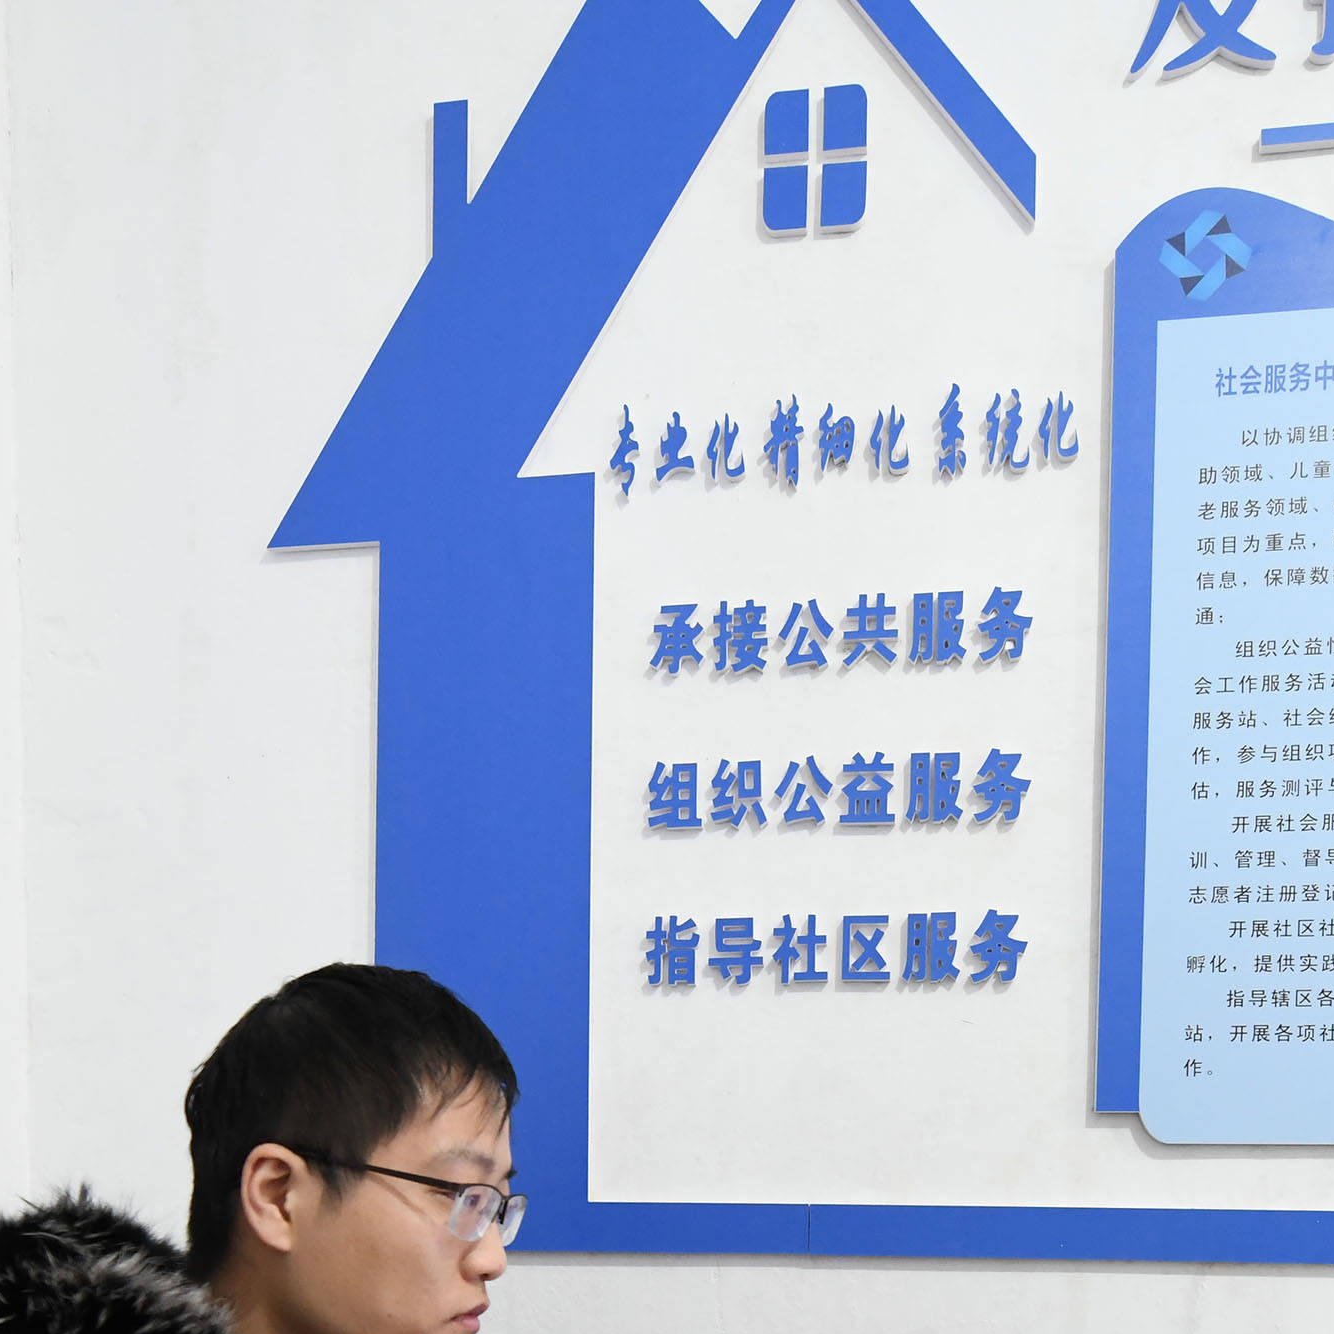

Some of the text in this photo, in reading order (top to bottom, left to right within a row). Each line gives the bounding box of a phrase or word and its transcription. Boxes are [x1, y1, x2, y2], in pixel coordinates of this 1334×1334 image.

[609, 383, 1080, 497] 专业化 精细化 系统化
[650, 586, 1034, 674] 承接公共服务
[1195, 607, 1224, 625] 通：
[648, 748, 1032, 830] 组织公益服务
[645, 909, 1028, 986] 指导社区服务
[1183, 1059, 1215, 1078] 作。
